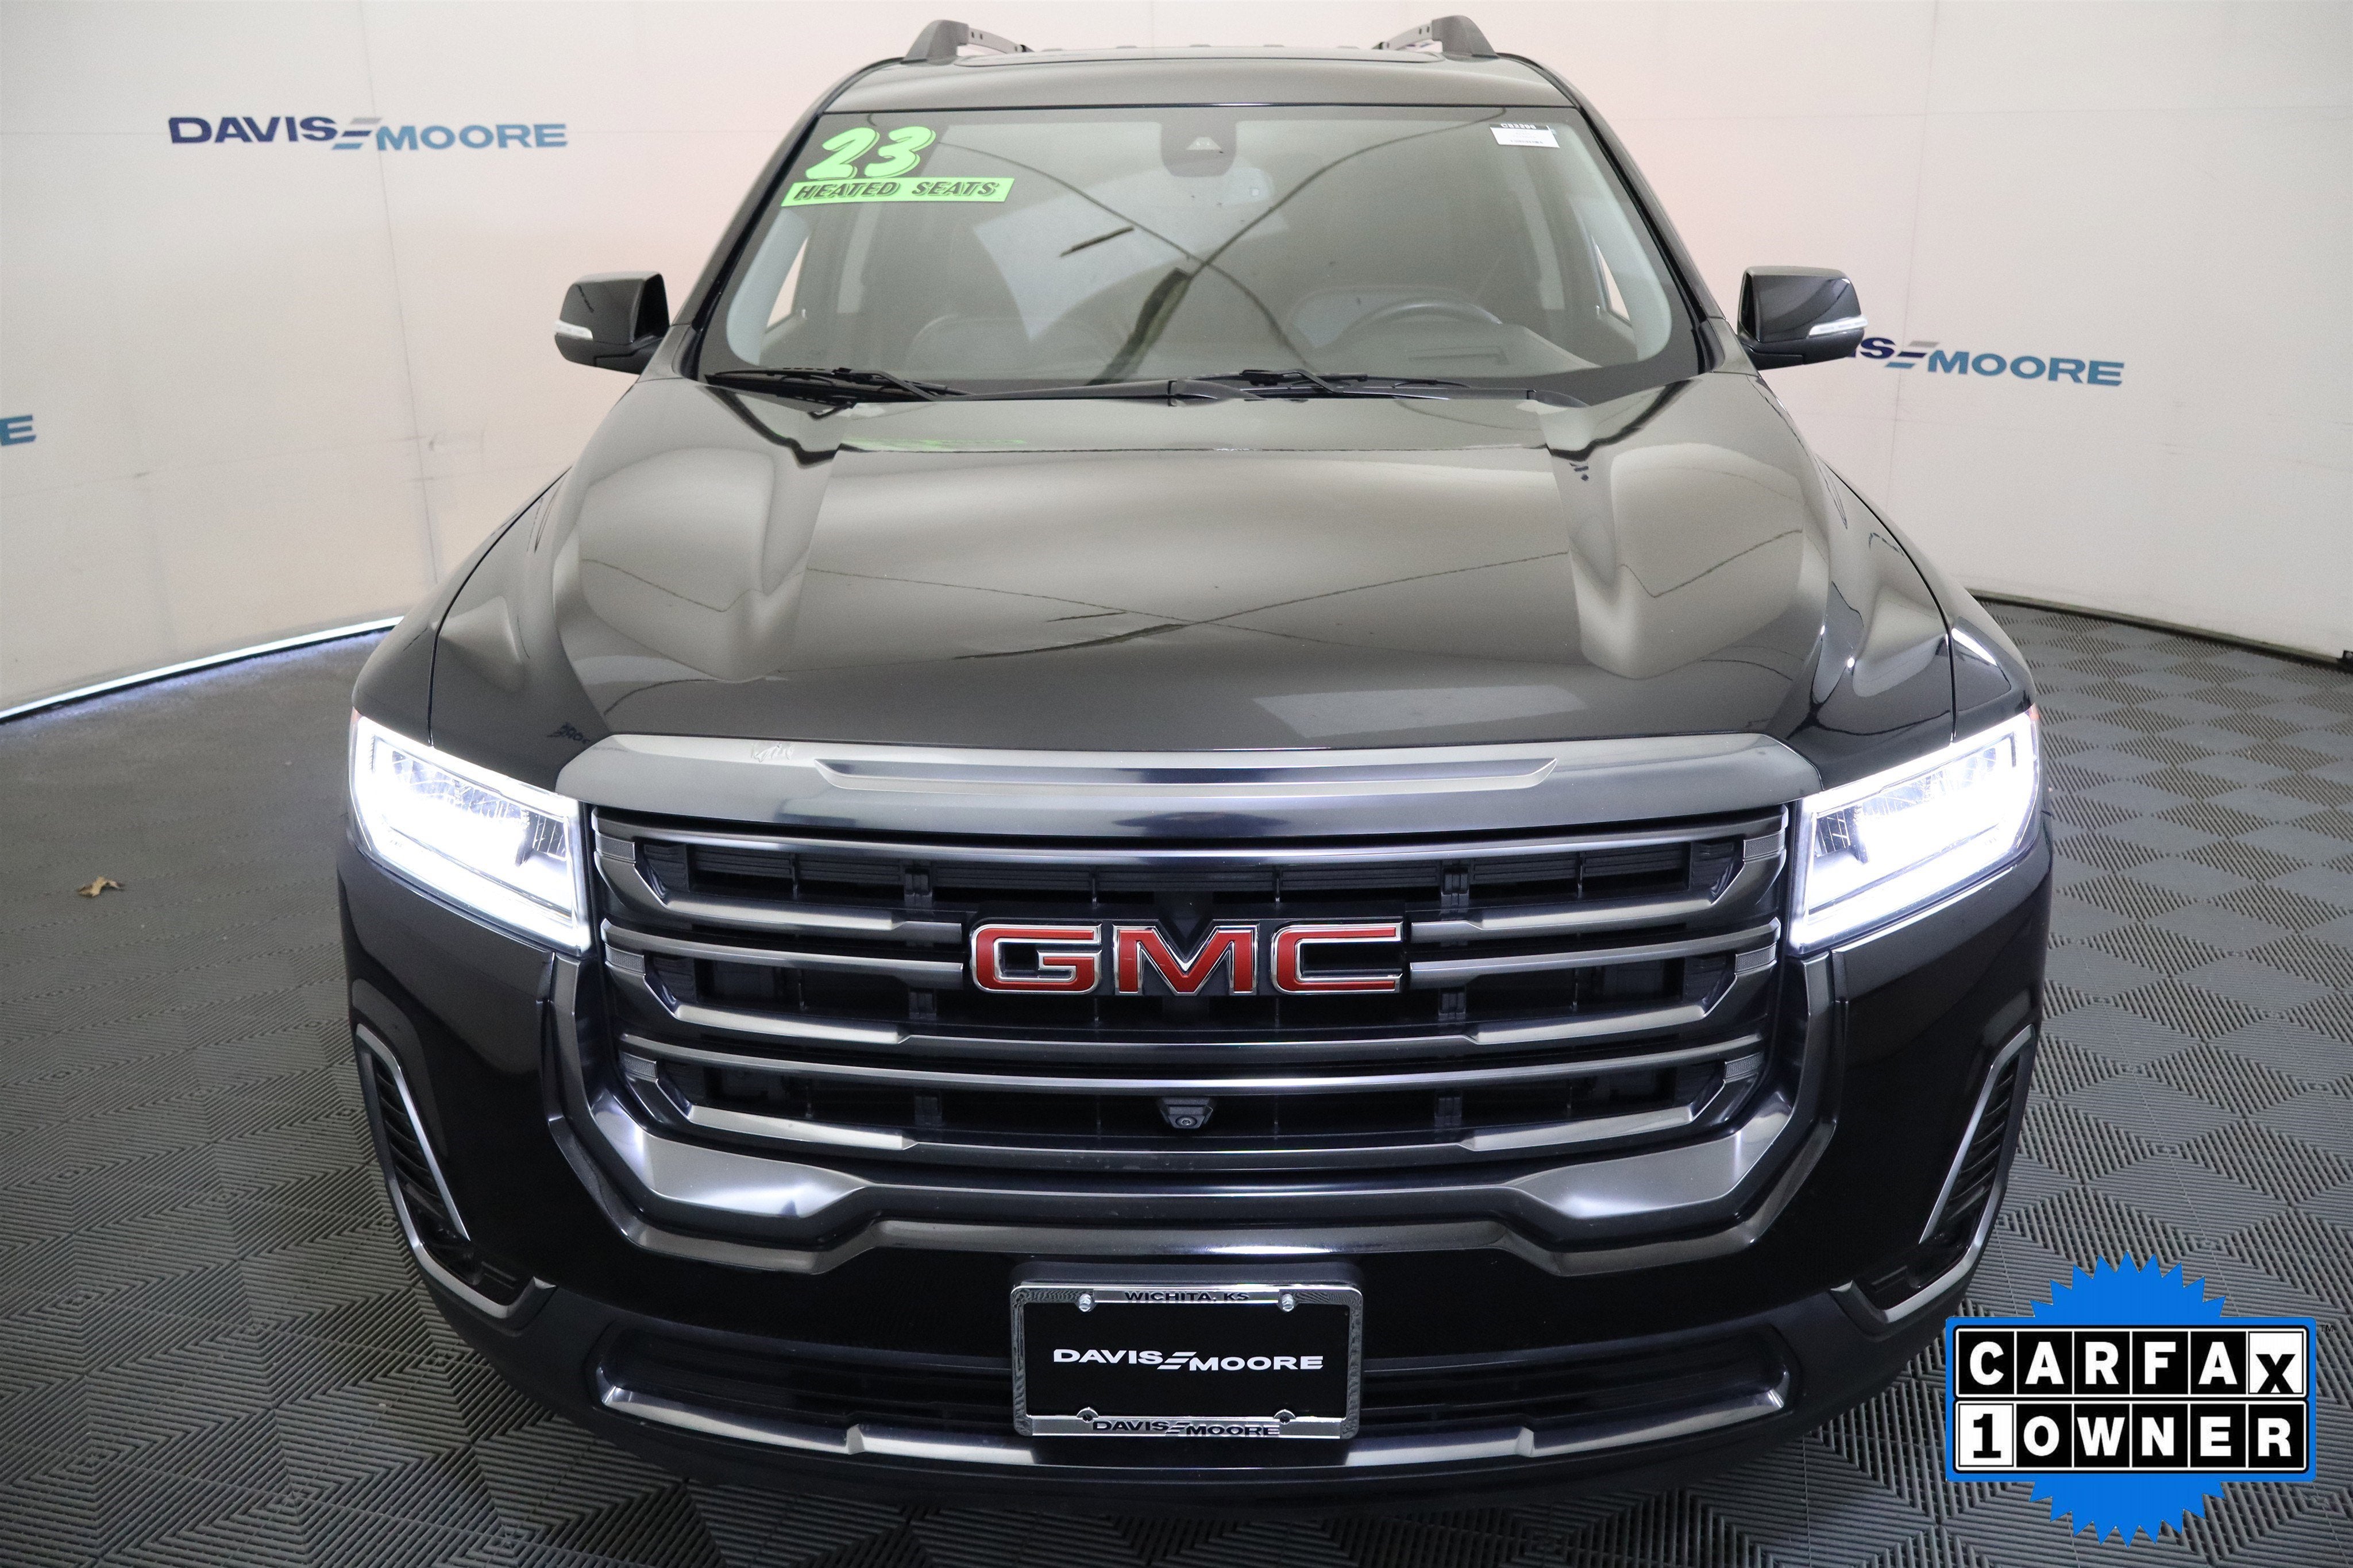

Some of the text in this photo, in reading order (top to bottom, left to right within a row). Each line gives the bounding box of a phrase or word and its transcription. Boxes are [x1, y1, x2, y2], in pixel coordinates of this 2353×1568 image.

[168, 116, 569, 151] DAVIS MOORE
[805, 126, 936, 180] 23
[793, 181, 1000, 200] HEATED SEATS
[1927, 350, 2125, 387] MOORE
[971, 922, 1403, 997] GMC
[1224, 1292, 1250, 1301] KS
[1053, 1349, 1324, 1371] DAVIS MOORE
[1092, 1421, 1280, 1436] DAVIS MOORE
